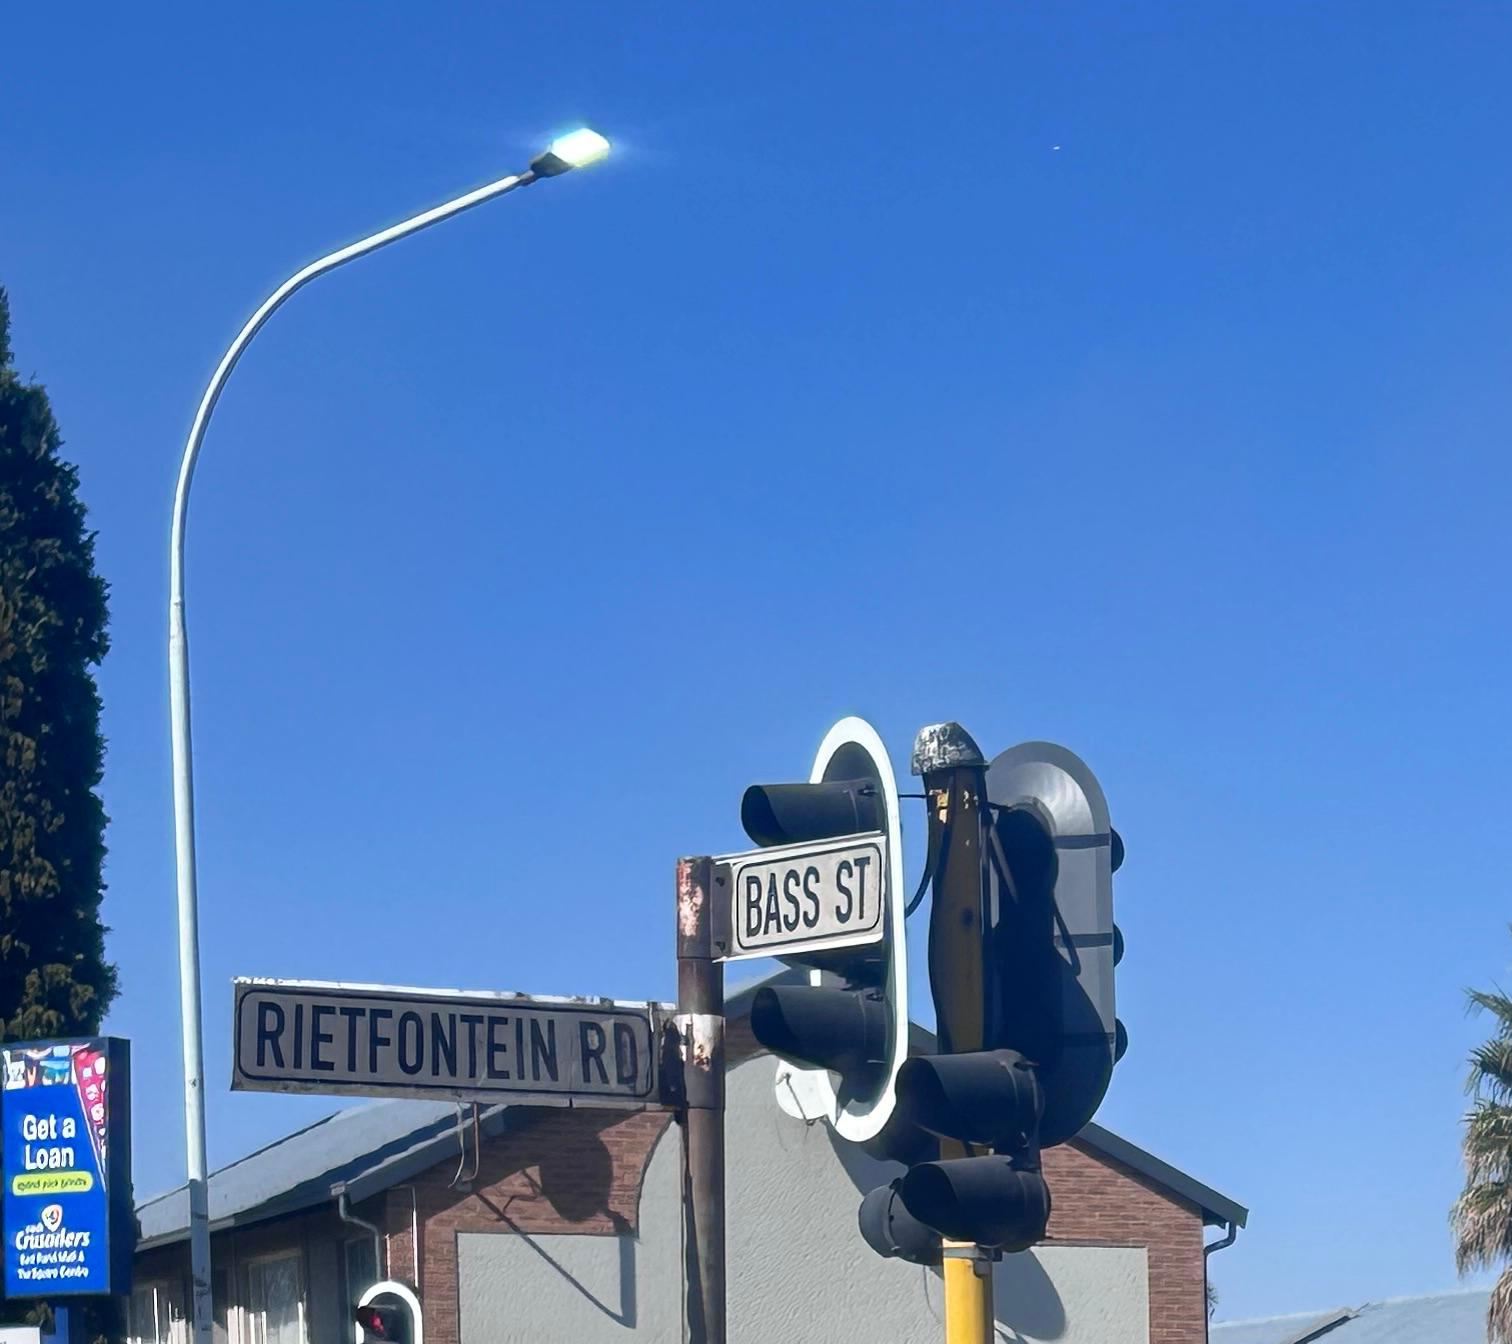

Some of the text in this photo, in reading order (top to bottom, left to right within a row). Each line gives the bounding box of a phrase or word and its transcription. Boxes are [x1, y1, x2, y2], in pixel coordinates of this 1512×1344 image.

[745, 855, 871, 939] BASS ST
[256, 1000, 639, 1087] RIETFONTEIN RD
[23, 1114, 76, 1140] Get a
[25, 1145, 75, 1170] Loan
